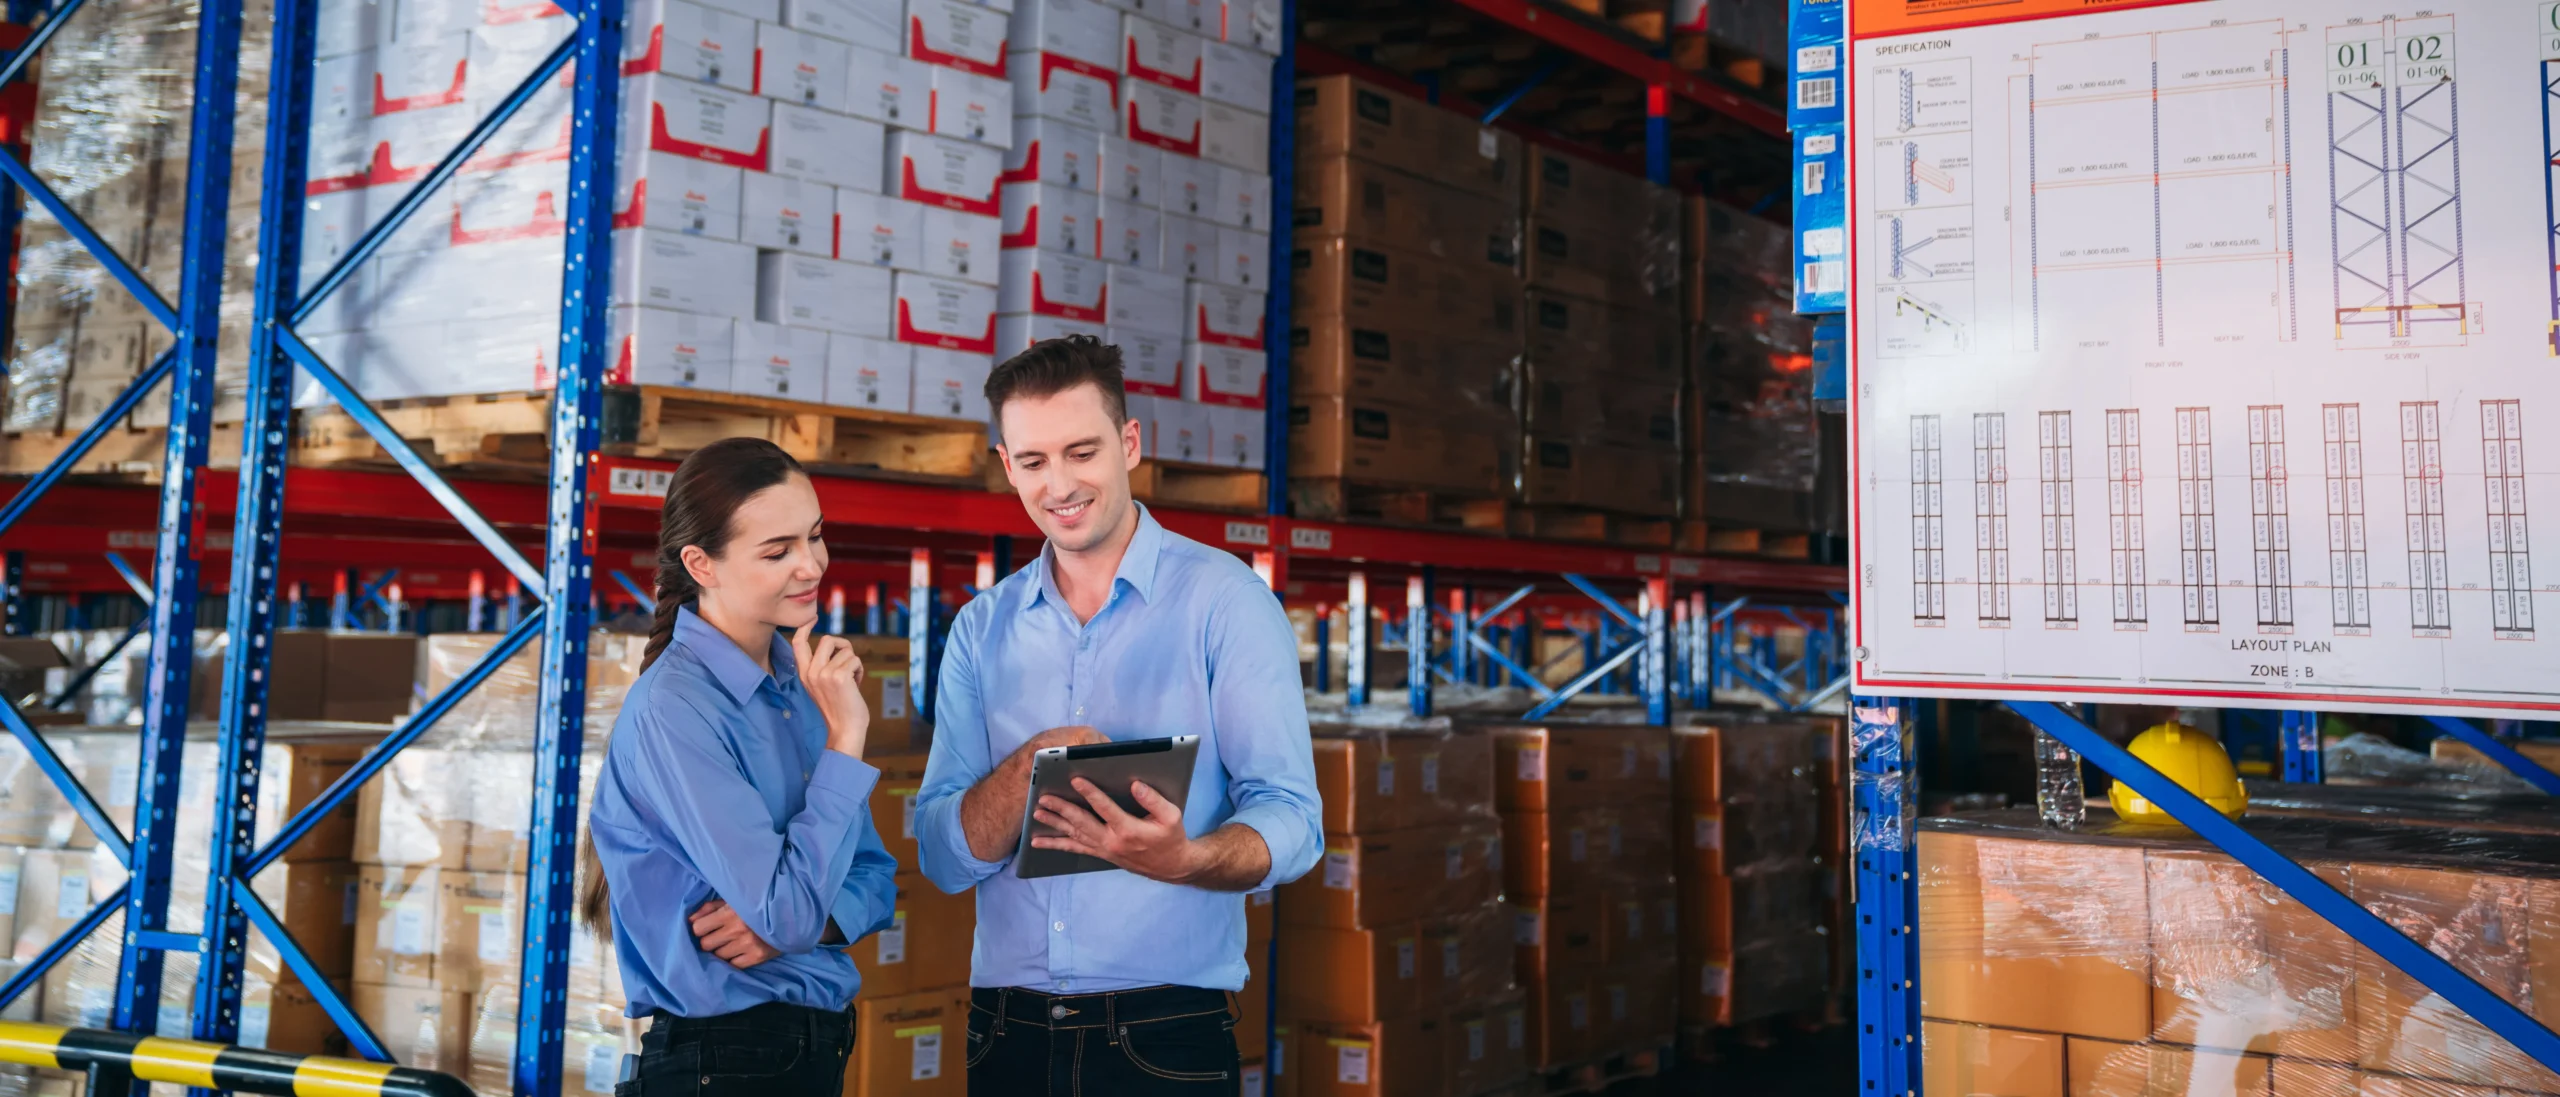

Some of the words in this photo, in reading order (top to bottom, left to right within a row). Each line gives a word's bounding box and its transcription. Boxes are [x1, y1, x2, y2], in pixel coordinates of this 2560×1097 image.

[1875, 39, 1951, 56] SPECIFICATION
[2337, 42, 2369, 67] 01
[2406, 36, 2442, 61] 02
[2182, 71, 2199, 79] LOAD
[2338, 71, 2377, 85] 01-06
[2407, 64, 2446, 79] 01-06
[2058, 166, 2075, 174] LOAD
[1865, 564, 1873, 588] 14500
[2231, 639, 2288, 652] LAYOUT
[2293, 640, 2332, 653] PLAN
[2250, 664, 2289, 677] ZONE
[2305, 667, 2314, 678] B
